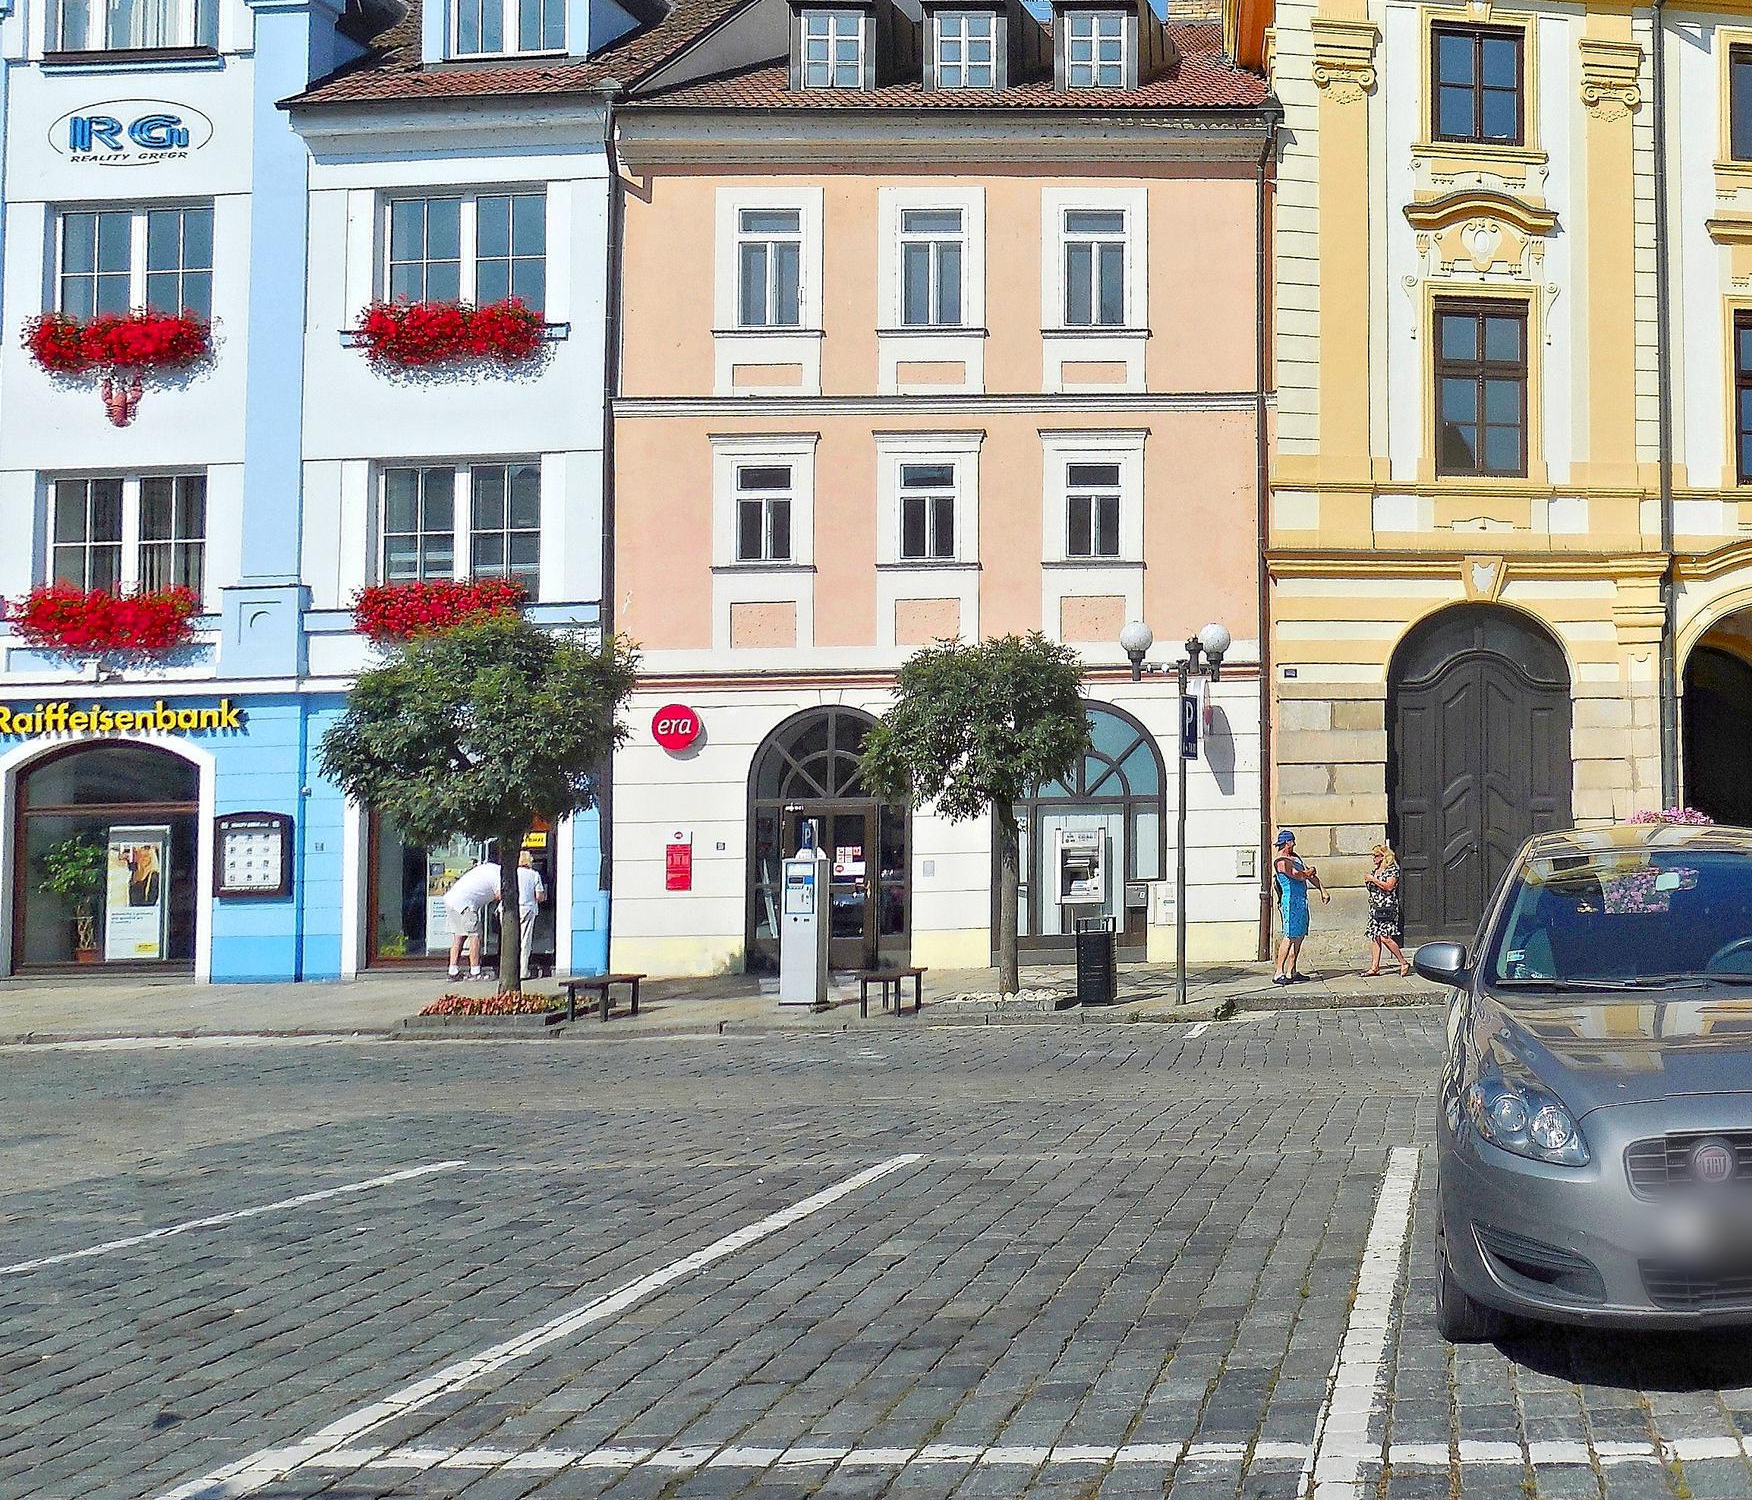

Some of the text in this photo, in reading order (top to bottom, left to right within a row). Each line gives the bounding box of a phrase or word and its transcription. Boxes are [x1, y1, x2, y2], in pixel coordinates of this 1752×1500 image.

[70, 151, 188, 163] REALITY GREGR
[0, 698, 242, 735] Raiffeisenbank
[1185, 701, 1194, 737] P
[657, 718, 692, 735] era
[1703, 1156, 1725, 1174] FIAT
